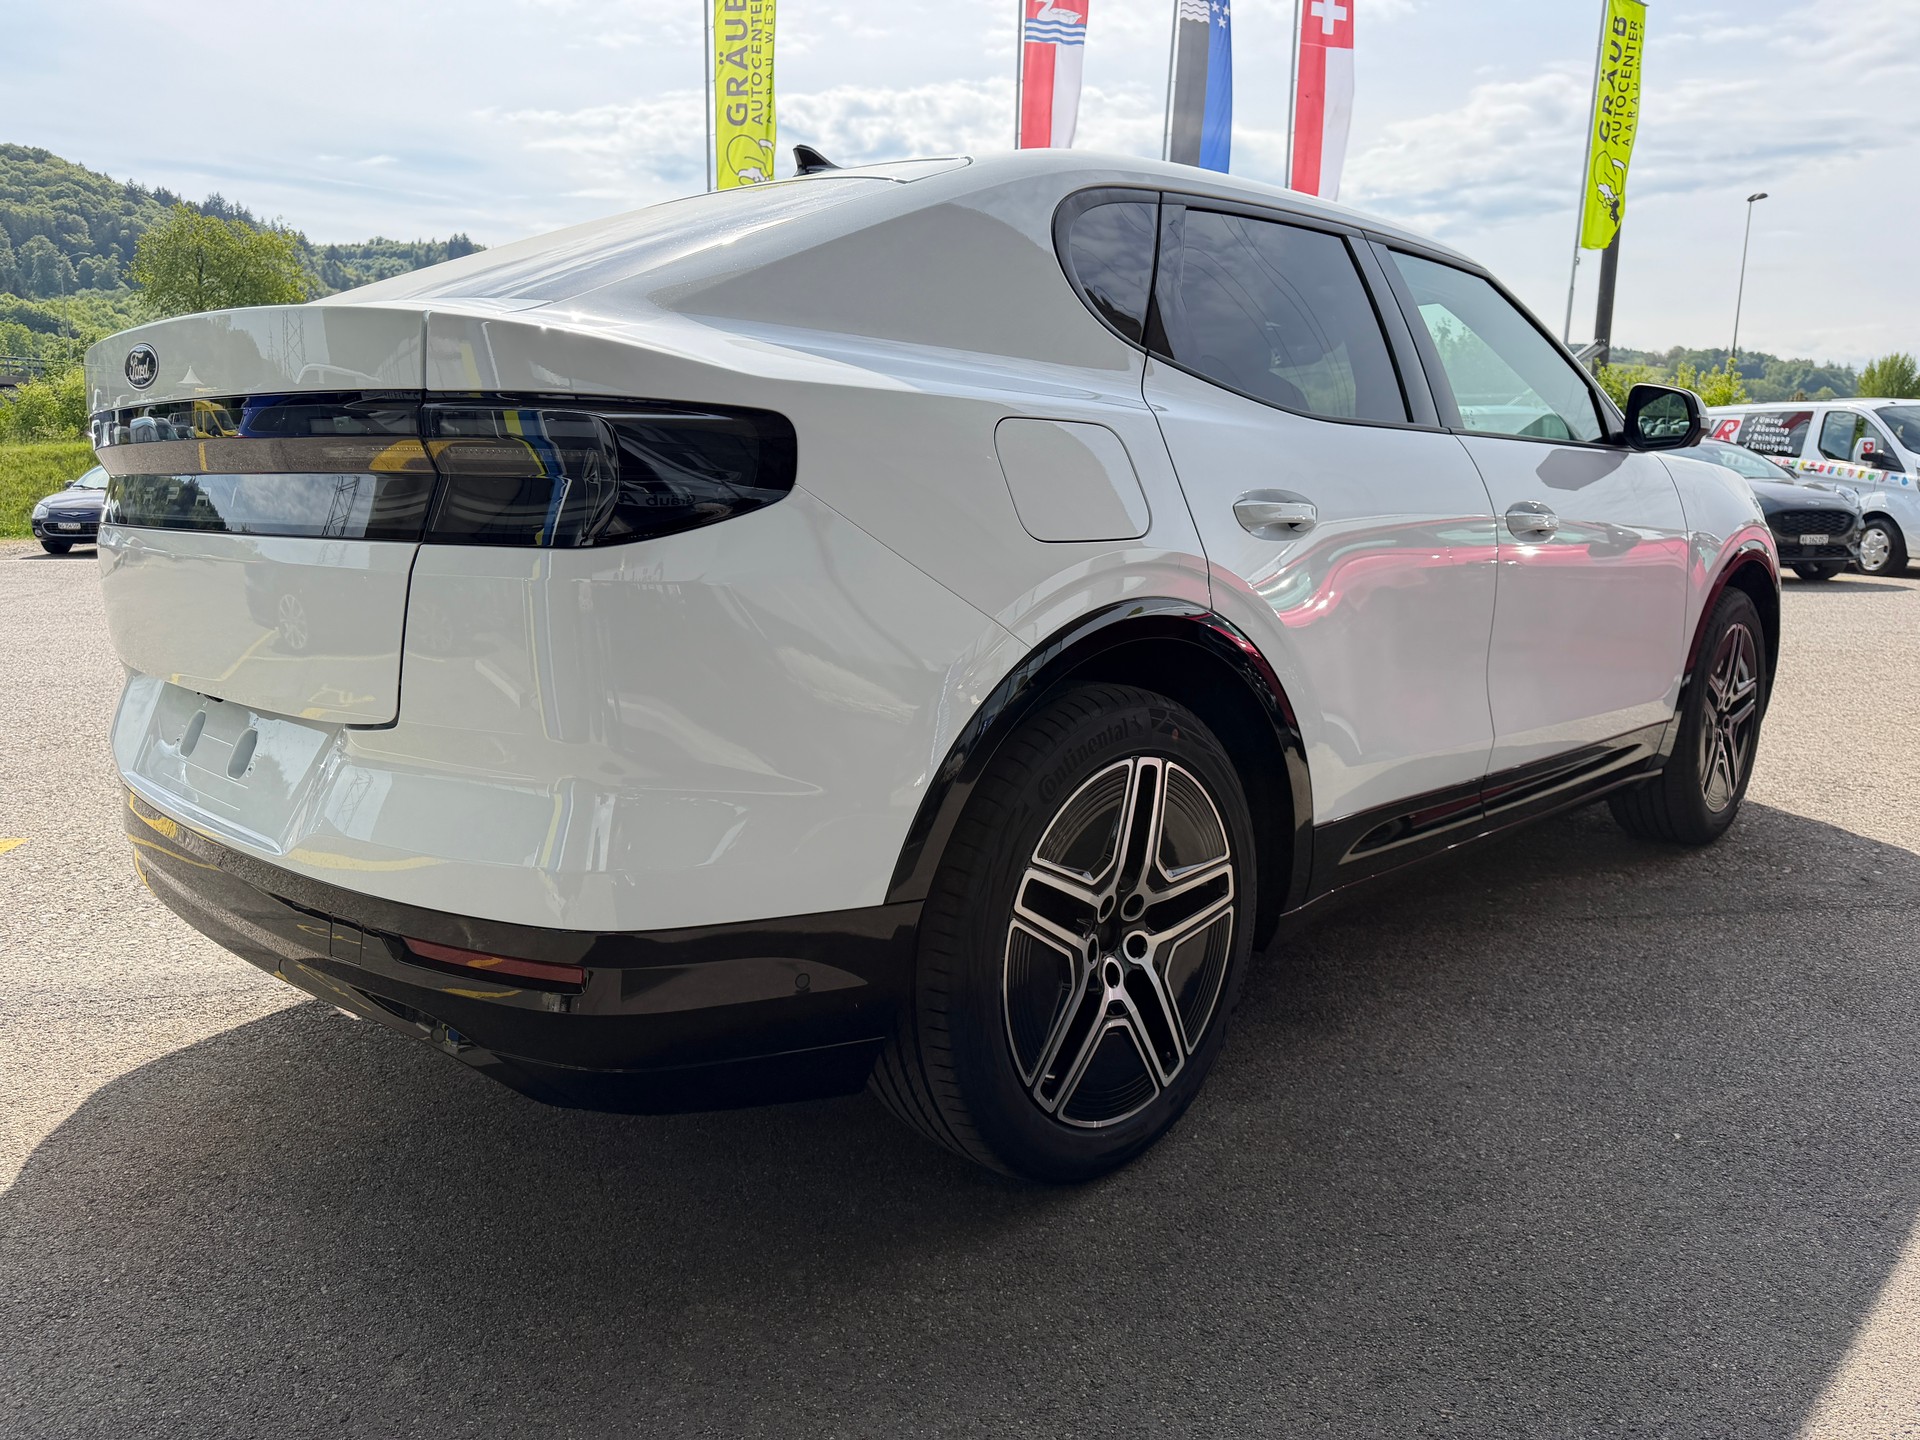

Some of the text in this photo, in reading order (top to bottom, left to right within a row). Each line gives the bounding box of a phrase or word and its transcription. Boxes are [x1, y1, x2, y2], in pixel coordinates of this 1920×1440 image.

[750, 0, 763, 126] AUTOCENTE
[765, 4, 774, 43] WES
[1599, 15, 1627, 142] GRÄUB
[1611, 20, 1638, 146] AUTOCENTER
[1622, 83, 1639, 147] AARAU
[129, 352, 150, 380] Ford
[1038, 717, 1129, 804] Continental
